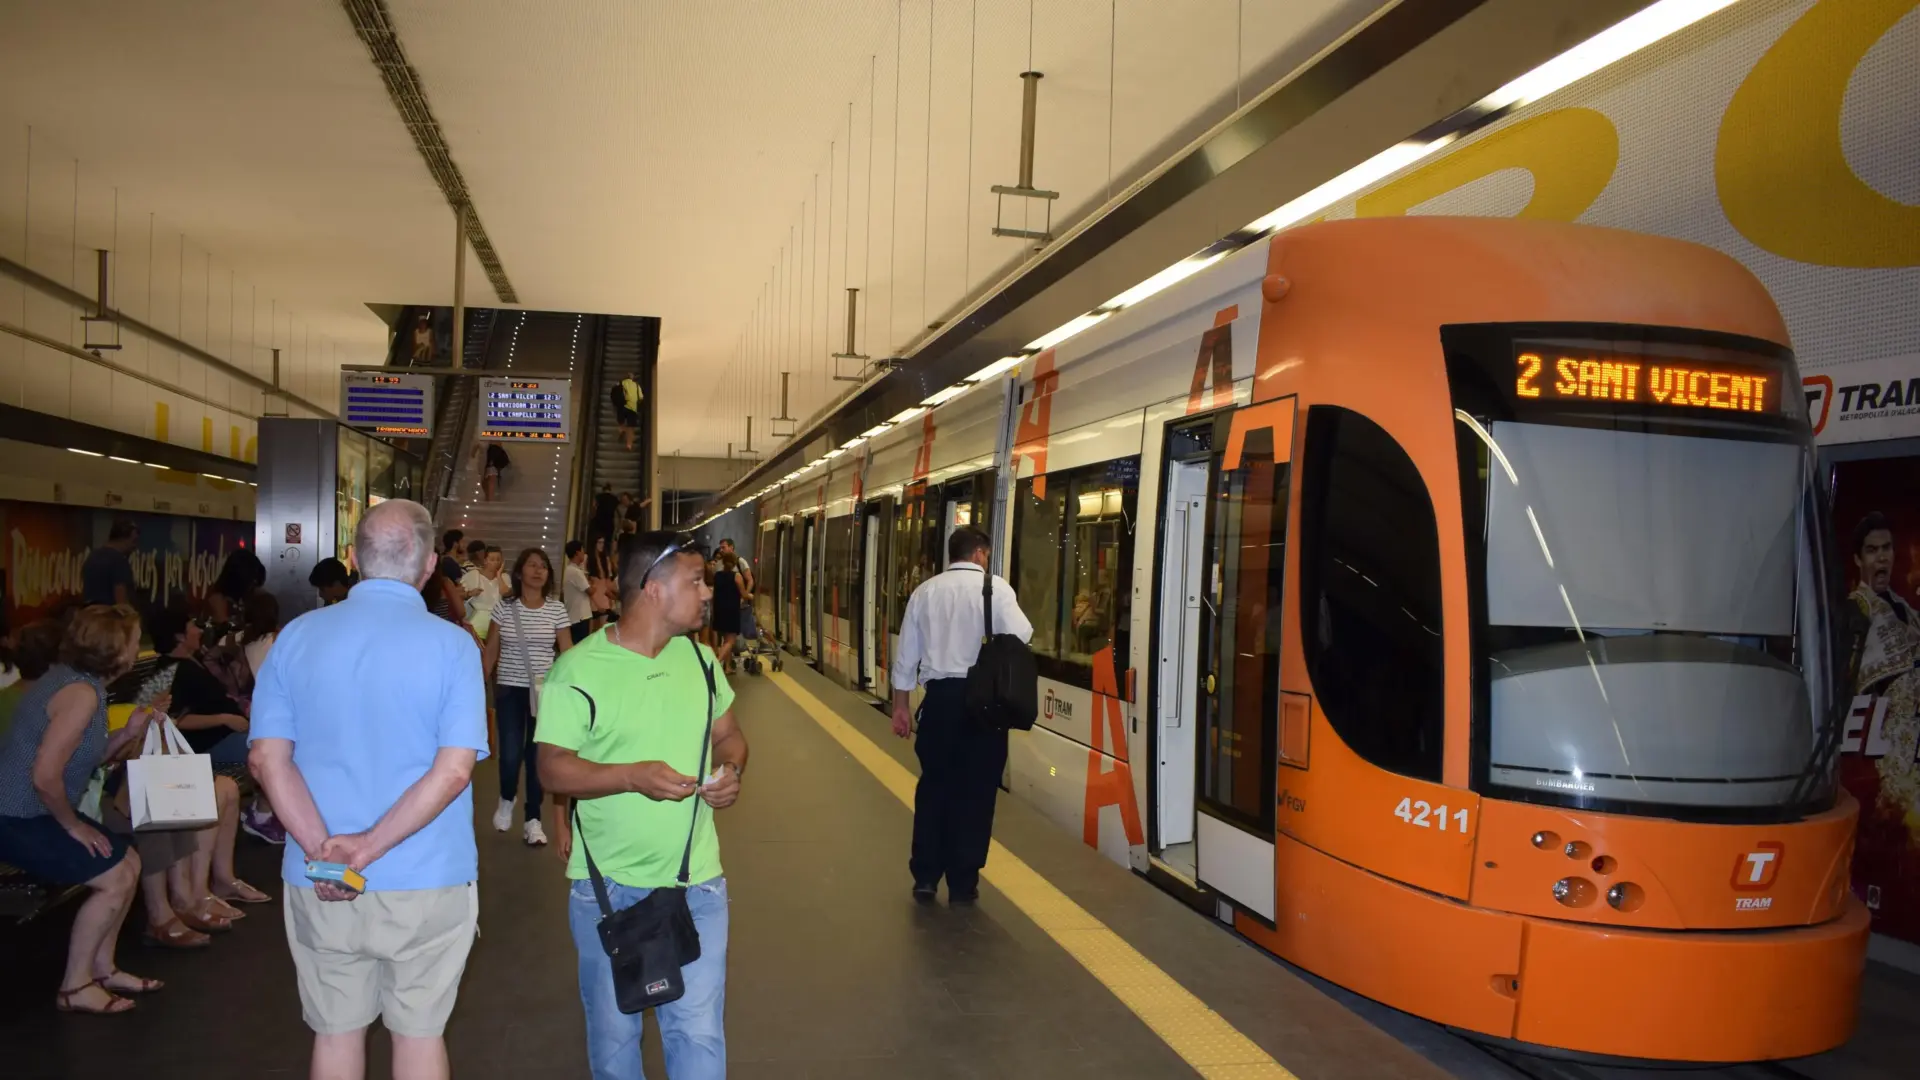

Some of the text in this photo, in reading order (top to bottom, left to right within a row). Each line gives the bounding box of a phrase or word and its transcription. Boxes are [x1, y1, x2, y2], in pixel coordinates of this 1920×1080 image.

[1516, 353, 1768, 412] 2 SANT VICENT
[1054, 697, 1073, 717] TRAM
[1394, 797, 1469, 834] 4211
[1735, 897, 1773, 908] TRAM
